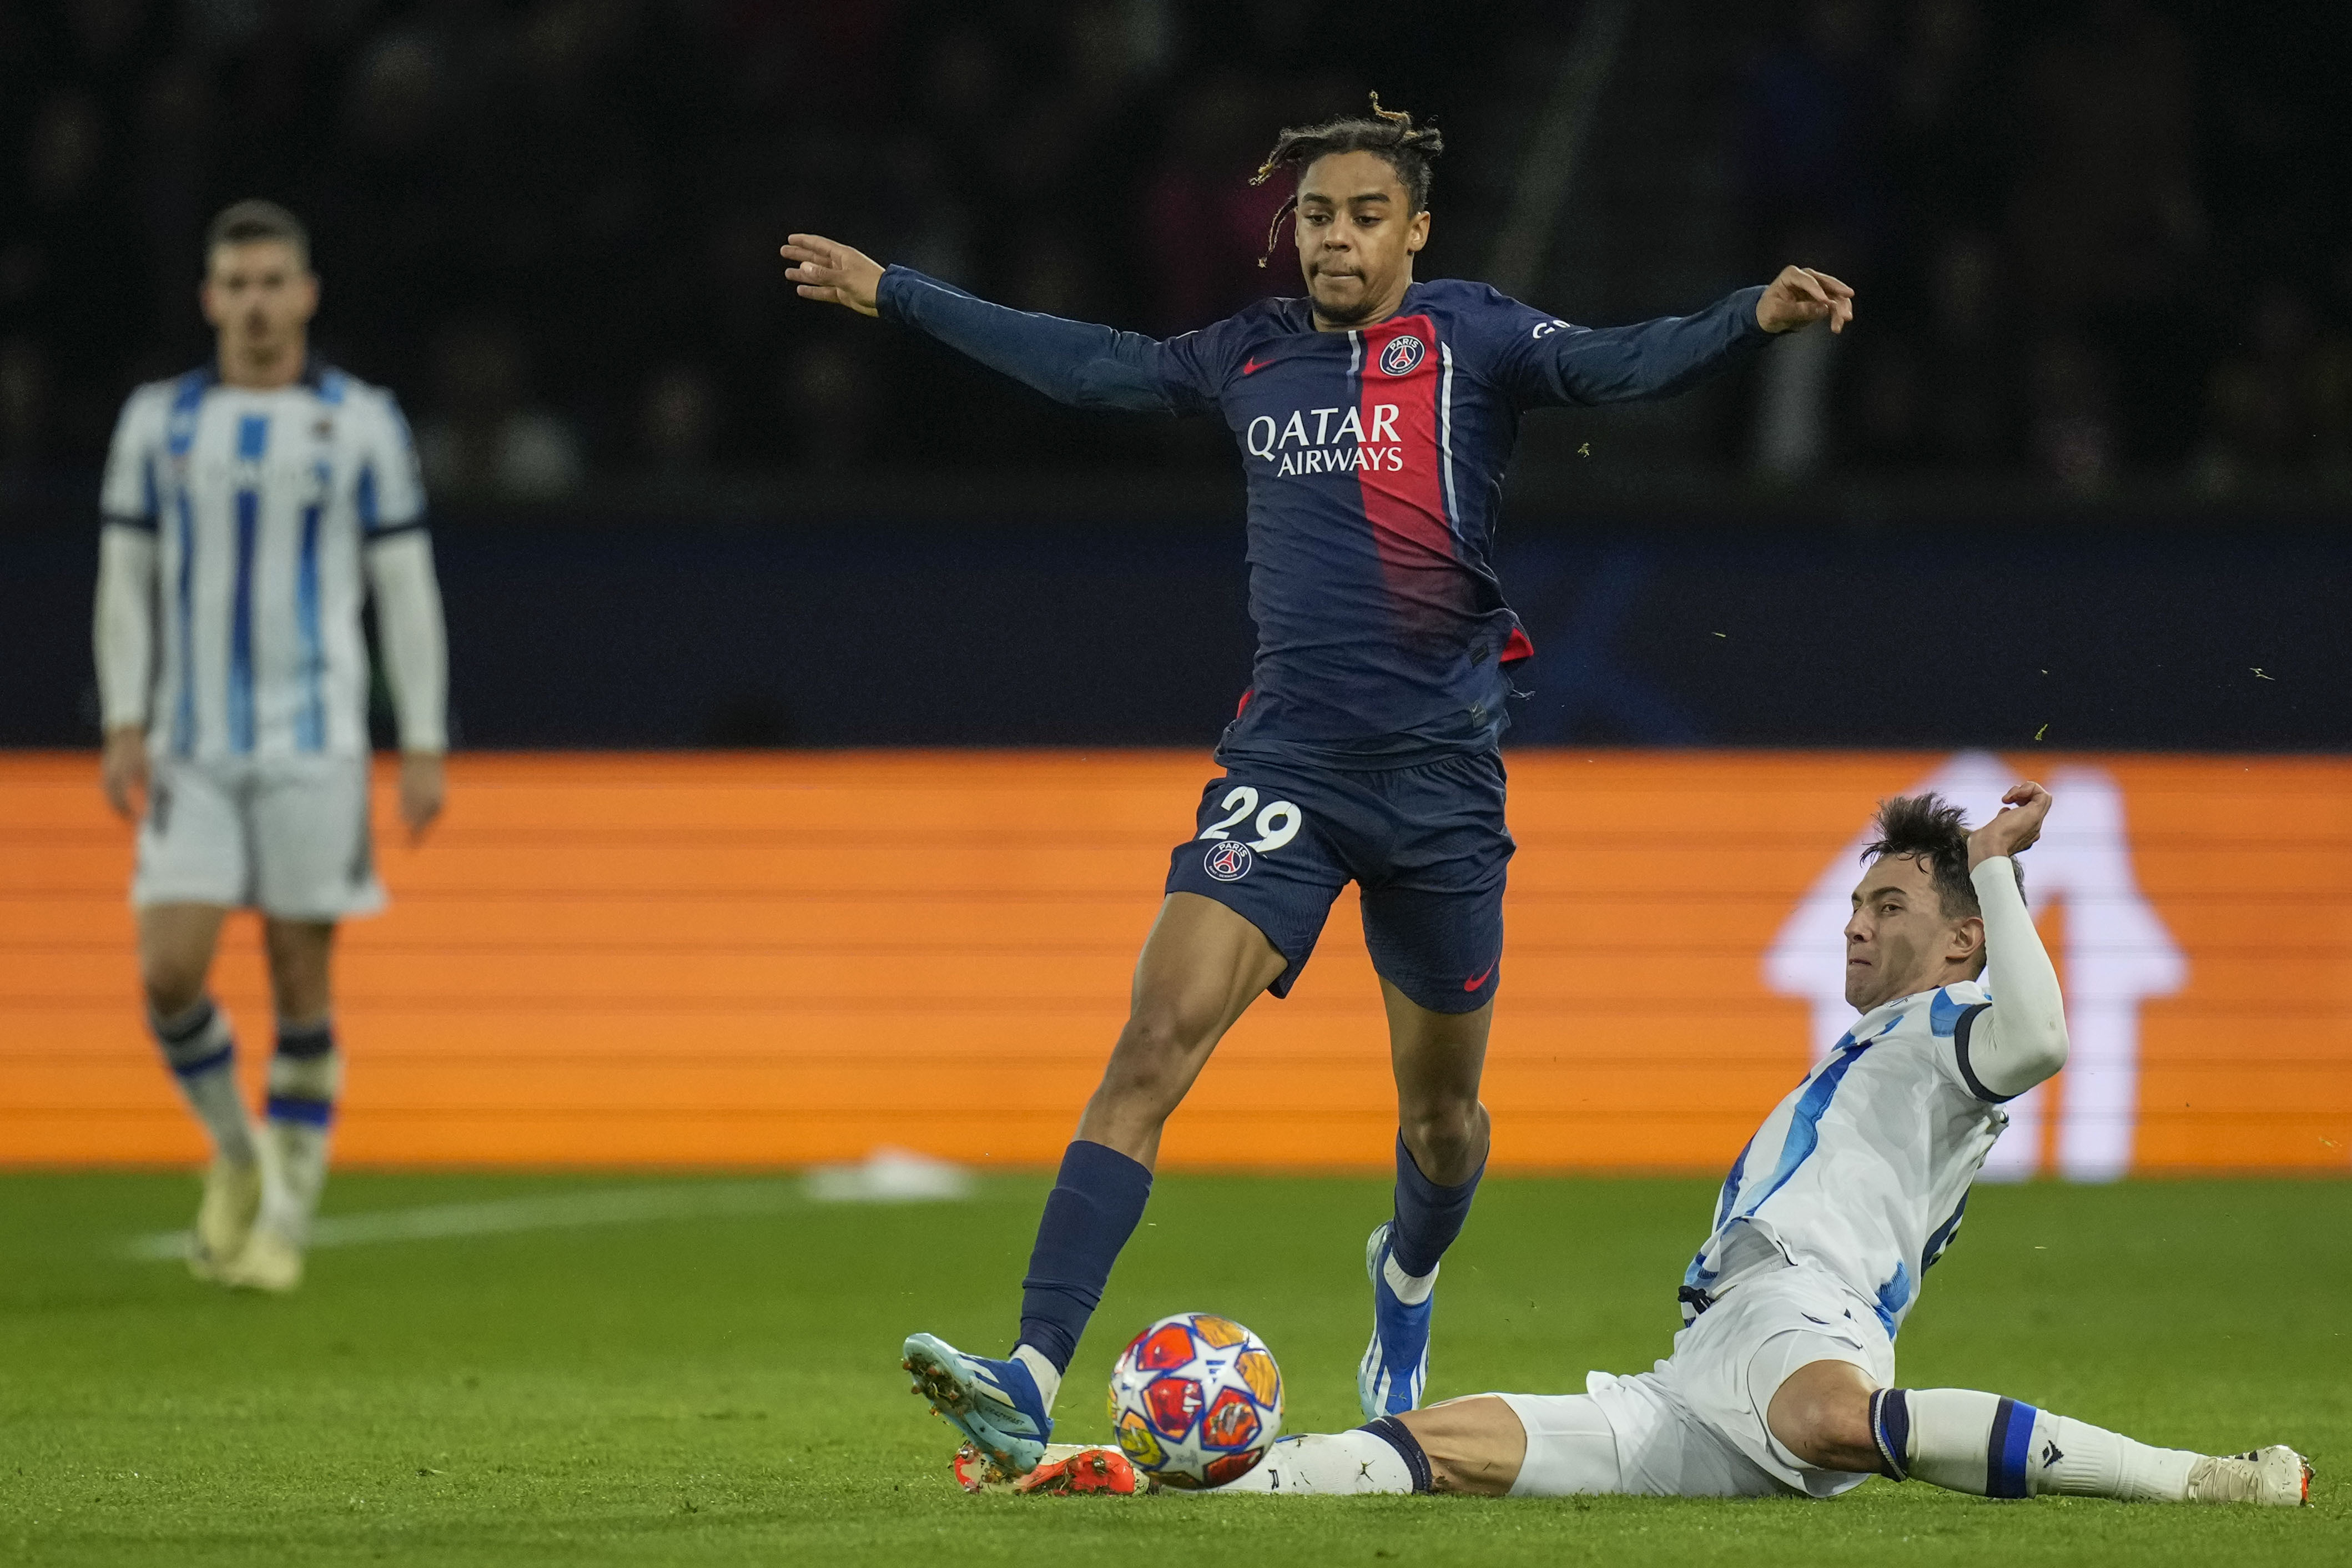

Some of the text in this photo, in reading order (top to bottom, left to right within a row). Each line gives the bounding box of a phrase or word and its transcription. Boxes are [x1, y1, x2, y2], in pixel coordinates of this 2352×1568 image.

[1389, 338, 1419, 349] PARIS
[1247, 404, 1402, 462] QATAR
[1277, 446, 1403, 477] AIRWAYS
[1198, 785, 1302, 853] 29
[1218, 843, 1247, 857] PARIS
